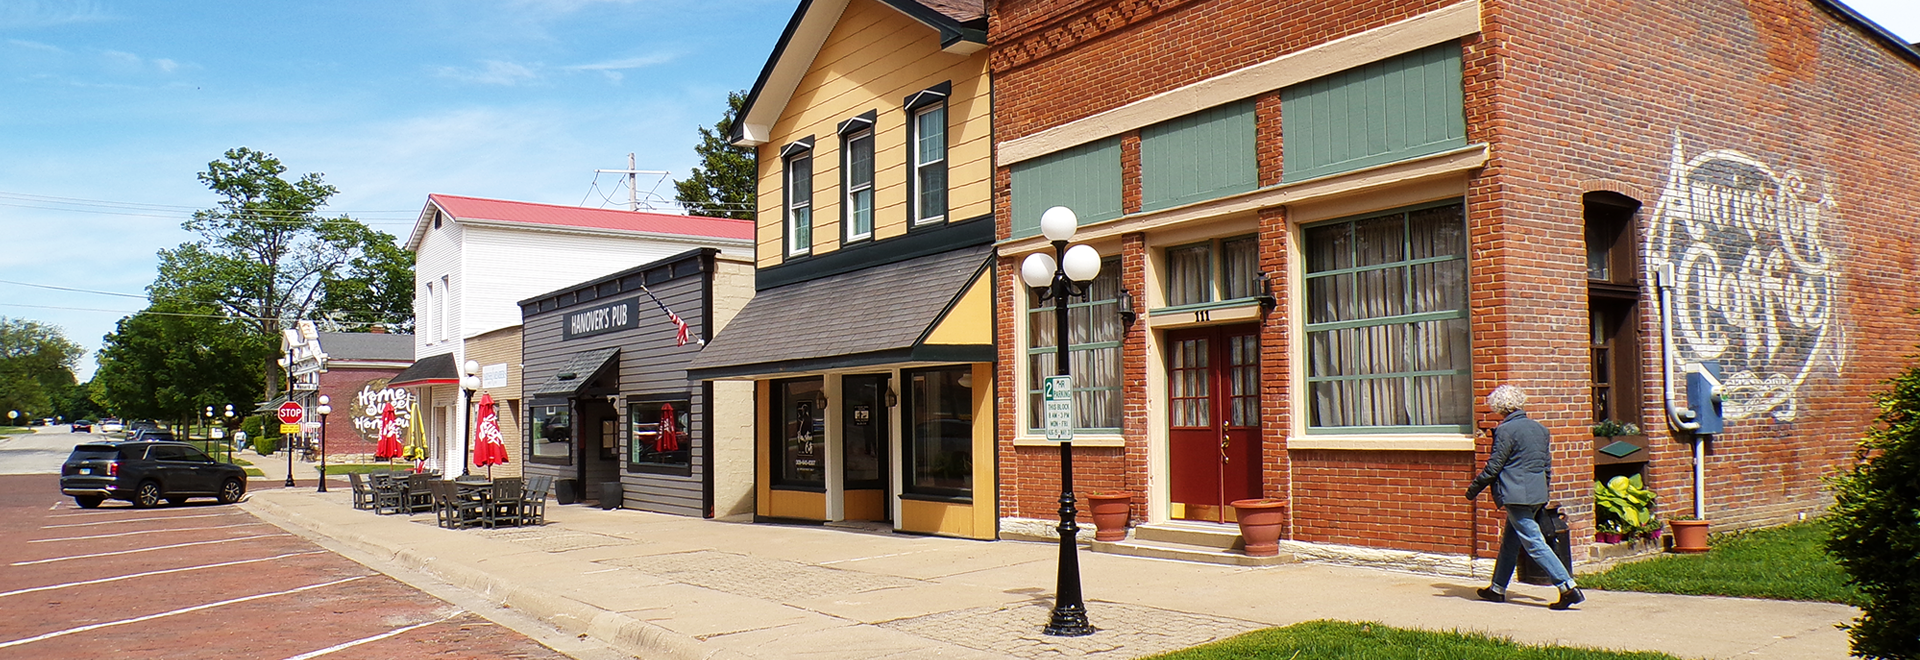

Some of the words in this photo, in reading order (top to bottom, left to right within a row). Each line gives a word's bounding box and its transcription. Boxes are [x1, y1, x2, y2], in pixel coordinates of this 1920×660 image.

[1676, 241, 1829, 367] Coffee
[571, 307, 610, 335] HANOVER'S
[611, 303, 628, 327] PUB
[1194, 310, 1210, 322] 111
[358, 385, 406, 407] Home
[1046, 381, 1052, 397] 2
[1053, 390, 1071, 399] PARKING
[280, 408, 302, 418] STOP
[1048, 403, 1056, 411] THIS
[1057, 403, 1069, 411] BLOCK
